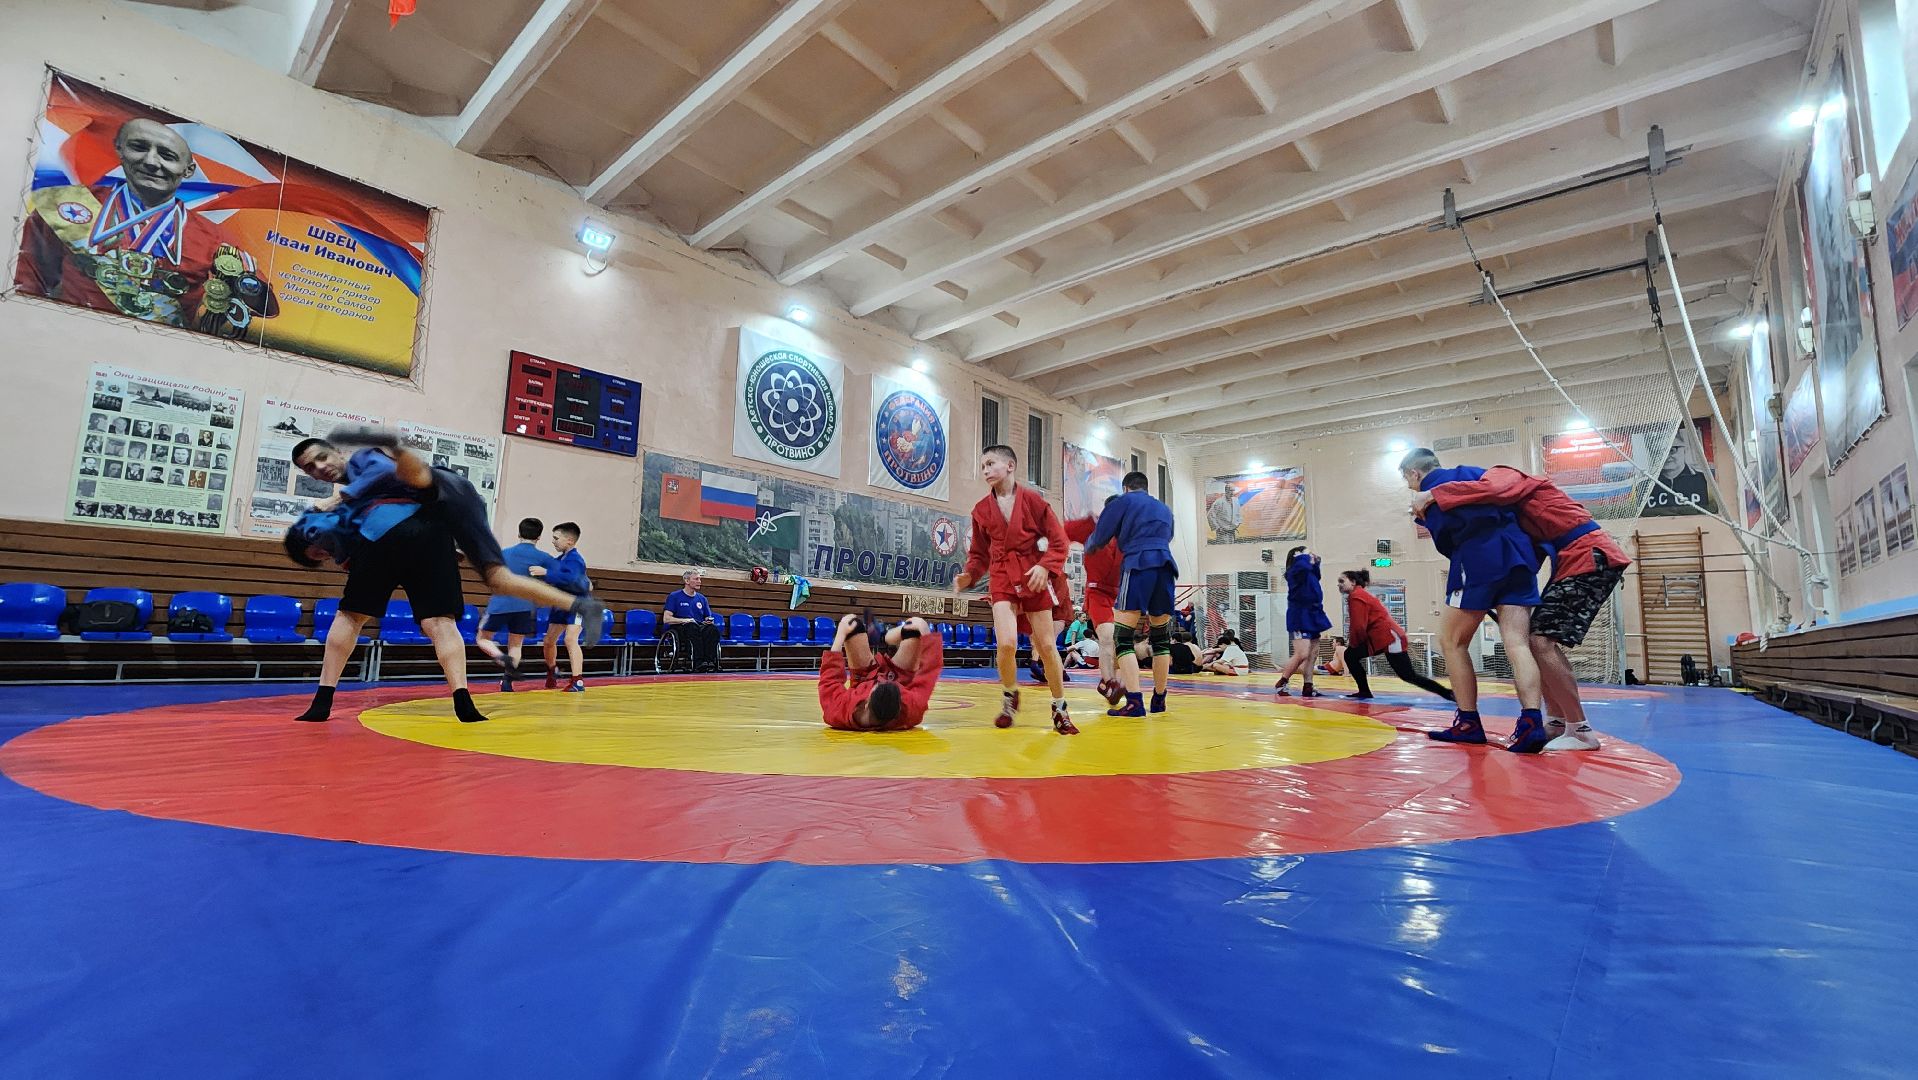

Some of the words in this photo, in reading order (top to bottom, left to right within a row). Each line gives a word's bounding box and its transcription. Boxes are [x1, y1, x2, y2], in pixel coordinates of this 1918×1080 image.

[308, 225, 357, 252] ШВЕЦ
[266, 230, 310, 252] Иван
[315, 245, 393, 278] Иванович
[278, 271, 330, 290] чемпион
[342, 289, 381, 305] призер
[292, 263, 371, 291] Семикратный
[278, 292, 314, 307] среди
[316, 303, 375, 322] ветеранов
[284, 282, 316, 297] Мира
[319, 292, 333, 301] по
[336, 296, 373, 312] Самбо
[113, 370, 134, 380] Они
[137, 375, 190, 390] защищали
[192, 385, 227, 398] Родину
[280, 401, 291, 409] Из
[293, 404, 334, 416] истории
[336, 411, 367, 423] САМБО
[462, 435, 486, 444] САМБО
[763, 434, 816, 459] ПРОТВИНО
[884, 450, 937, 483] ПРОТВИНО
[813, 544, 963, 585] ПРОТВИНО
